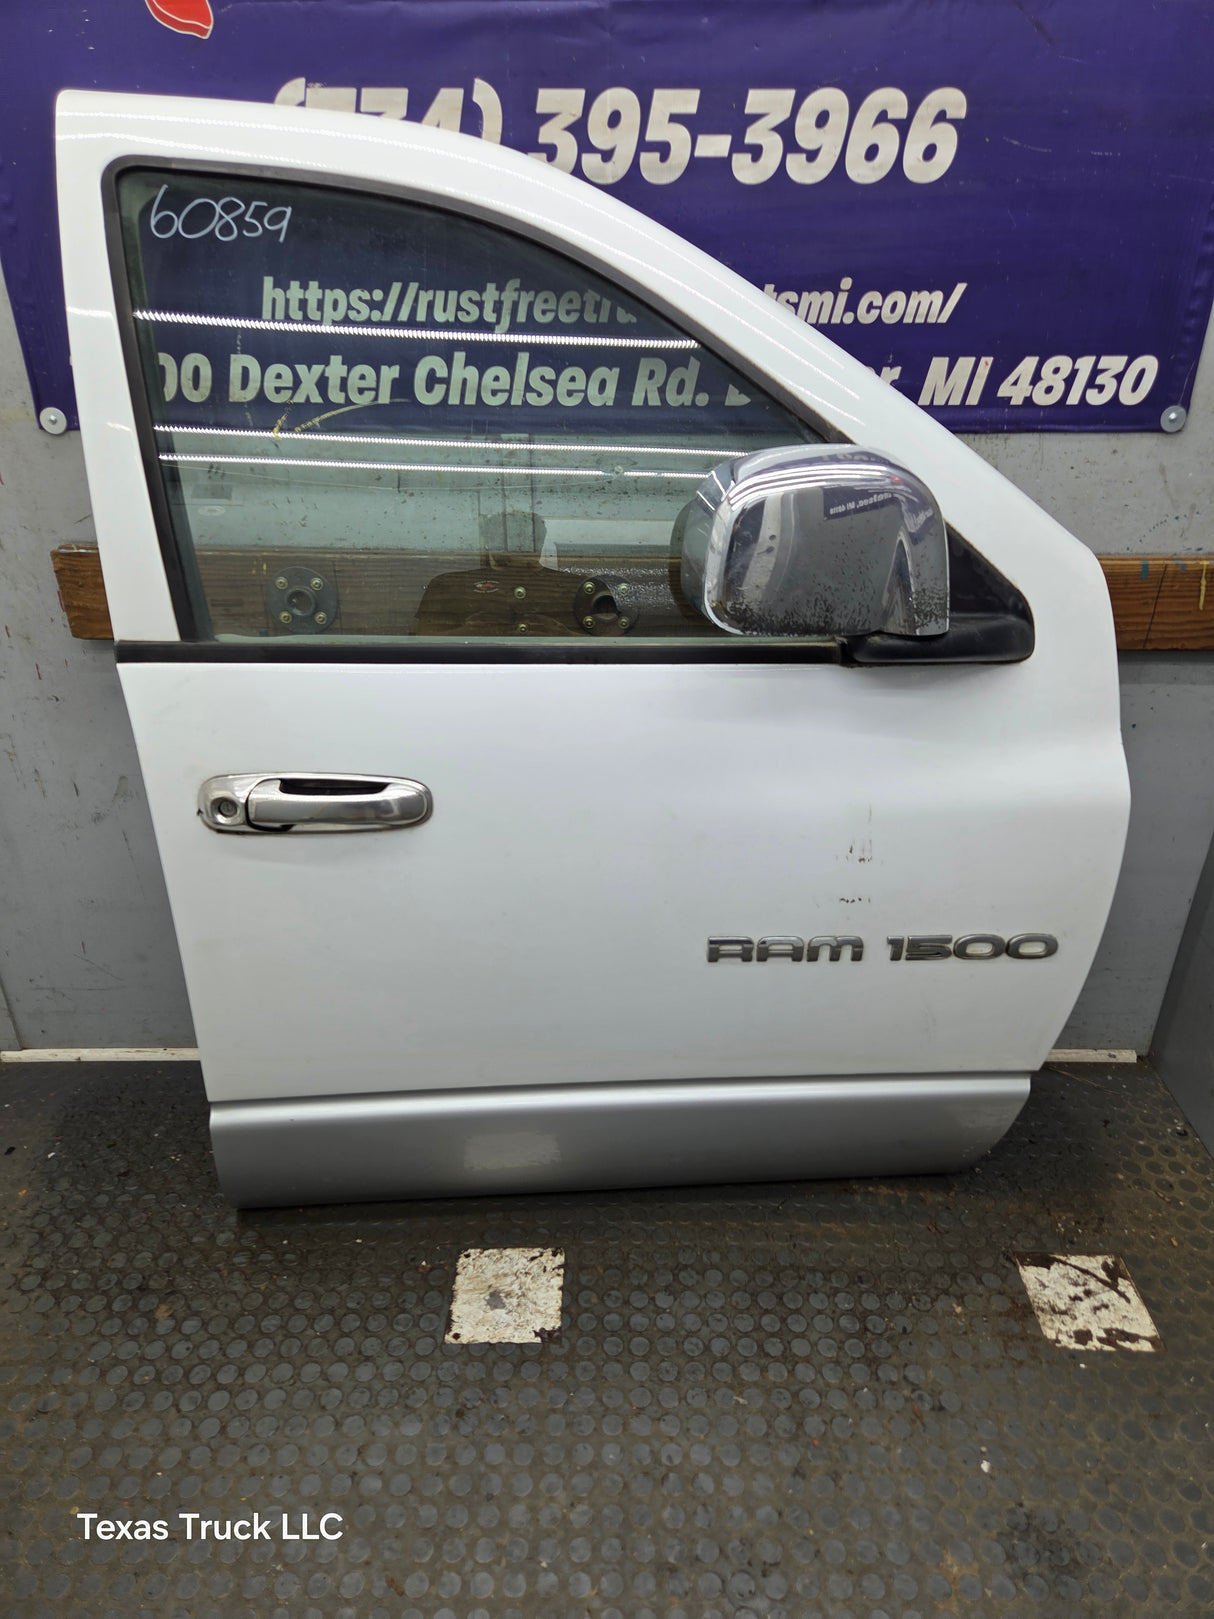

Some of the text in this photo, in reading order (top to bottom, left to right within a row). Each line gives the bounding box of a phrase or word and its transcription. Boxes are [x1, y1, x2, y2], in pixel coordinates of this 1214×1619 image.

[527, 87, 967, 184] 395-3966
[149, 184, 291, 243] 60859
[229, 353, 400, 405] Dexter
[413, 351, 620, 408] Chelsea
[631, 355, 710, 408] Rd.
[918, 356, 994, 406] MI
[997, 354, 1160, 406] 48130
[706, 933, 1060, 963] RAM 1500
